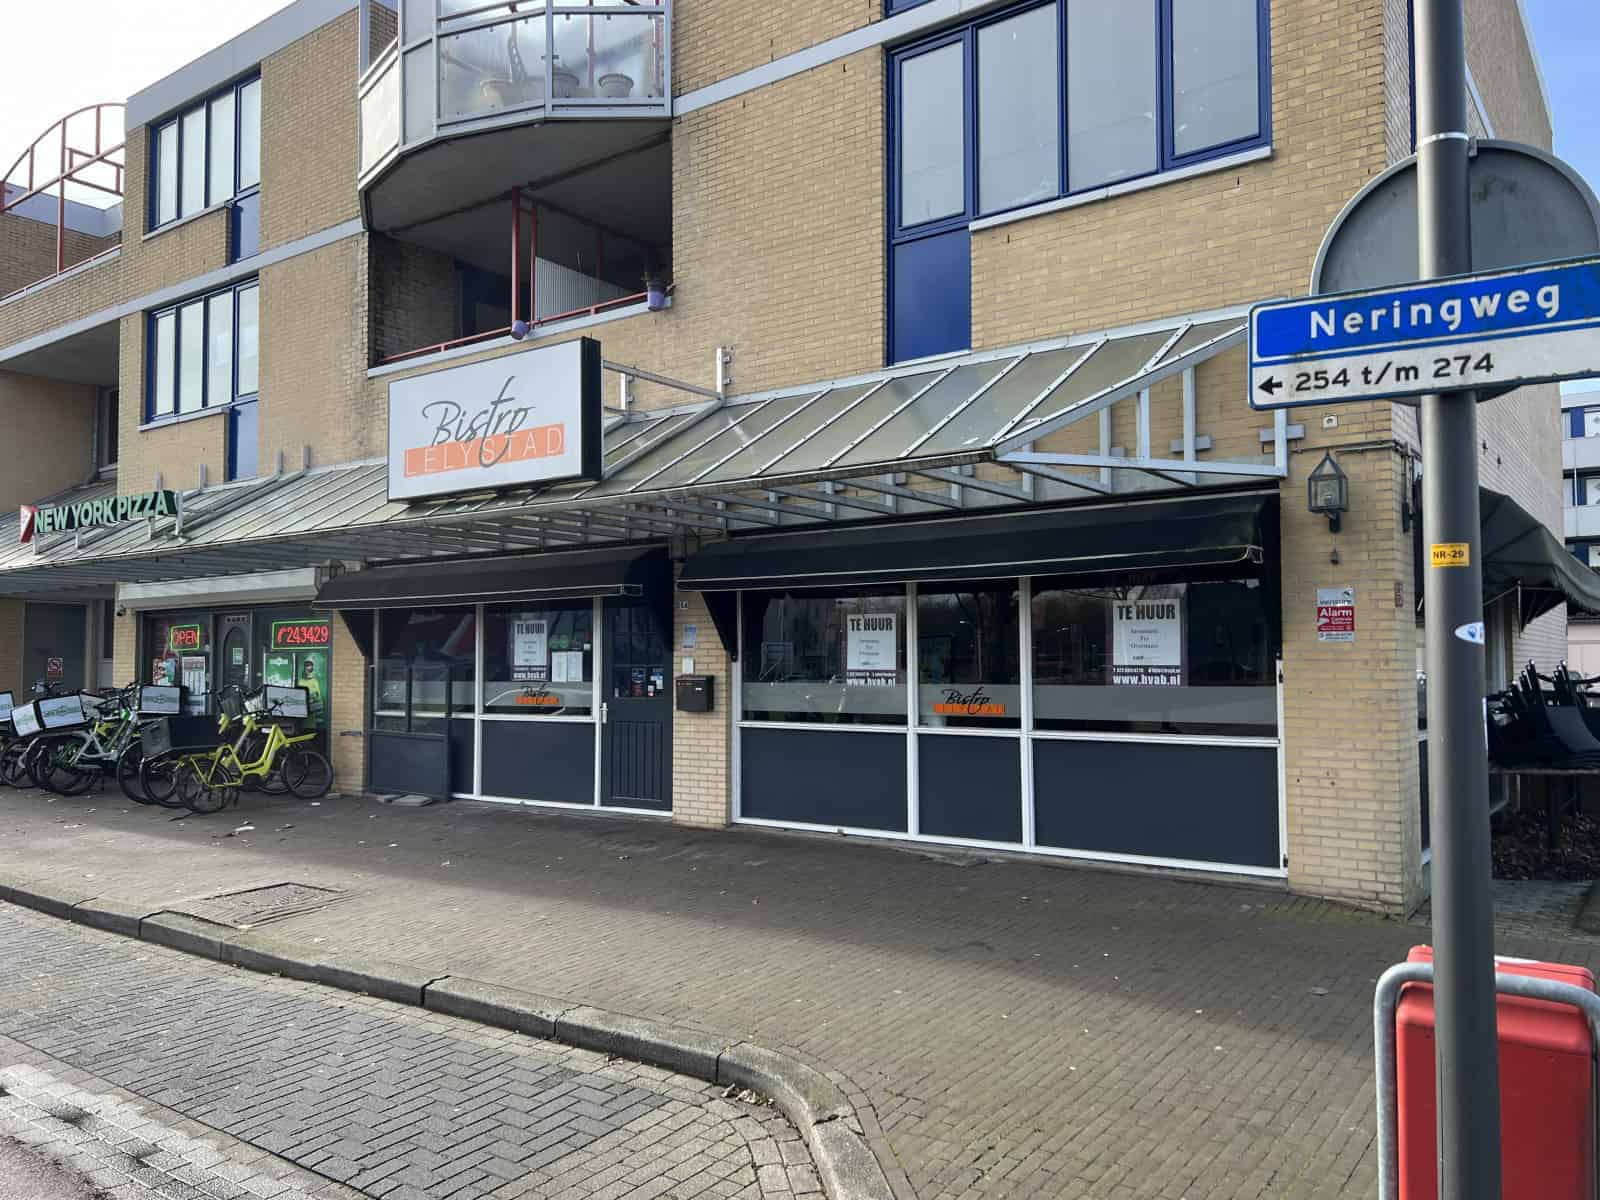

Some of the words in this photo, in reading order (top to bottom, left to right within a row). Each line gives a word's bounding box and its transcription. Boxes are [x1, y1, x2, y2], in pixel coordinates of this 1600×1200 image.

[1309, 283, 1561, 339] Neringweg
[1295, 368, 1350, 392] 254
[1361, 361, 1419, 385] t/m
[1432, 352, 1494, 378] 274
[422, 376, 536, 468] Bistro
[405, 427, 563, 476] LELYSTAD
[34, 505, 68, 534] NEW
[71, 497, 116, 528] YORK
[117, 489, 168, 522] PIZZA
[1432, 549, 1464, 559] NR-29
[1117, 605, 1133, 620] TE
[1135, 604, 1176, 620] HUUR
[1319, 607, 1353, 617] Alarm
[850, 618, 863, 632] TE
[863, 617, 893, 632] HUUR
[173, 629, 198, 645] OPEN
[287, 624, 328, 643] 243429
[1112, 674, 1181, 686] www.hvab.nl
